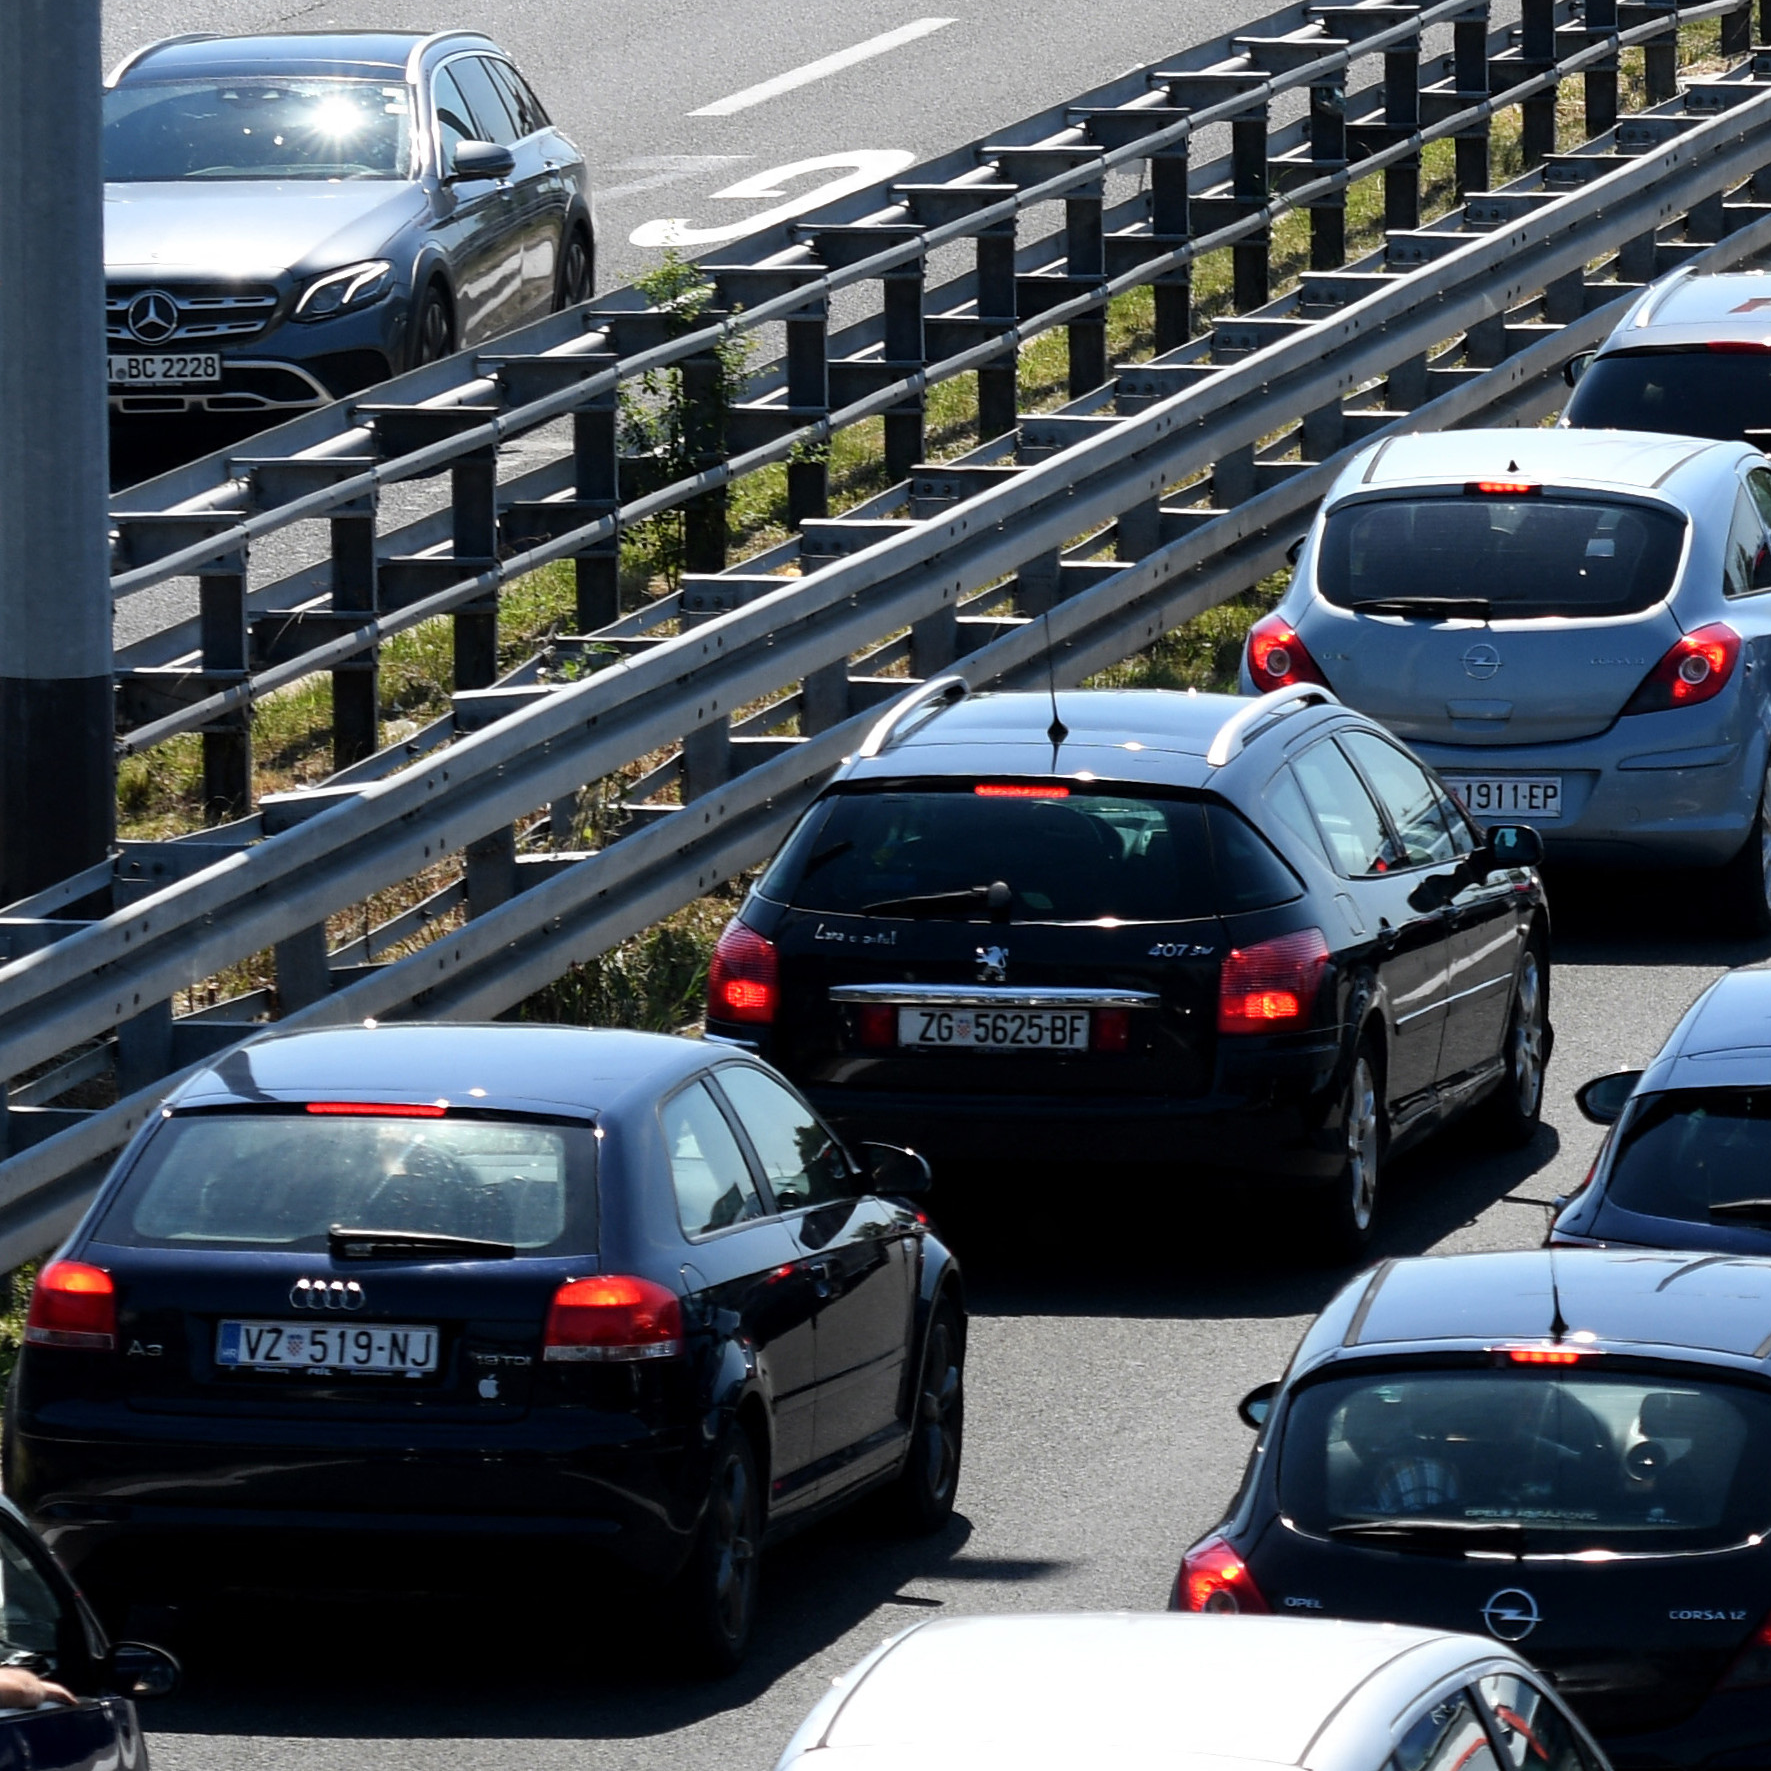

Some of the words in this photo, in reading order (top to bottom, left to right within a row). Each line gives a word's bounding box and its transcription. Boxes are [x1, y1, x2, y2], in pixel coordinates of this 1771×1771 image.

[127, 358, 156, 379] BC
[161, 356, 216, 378] 2228
[1148, 943, 1185, 958] 407
[918, 1012, 954, 1042] ZG
[973, 1013, 1085, 1046] 5625-BF
[127, 1339, 163, 1356] A3
[243, 1326, 283, 1362] VZ
[309, 1329, 432, 1367] 519-NJ
[1283, 1595, 1324, 1610] OPEL
[1668, 1609, 1725, 1621] CORSA
